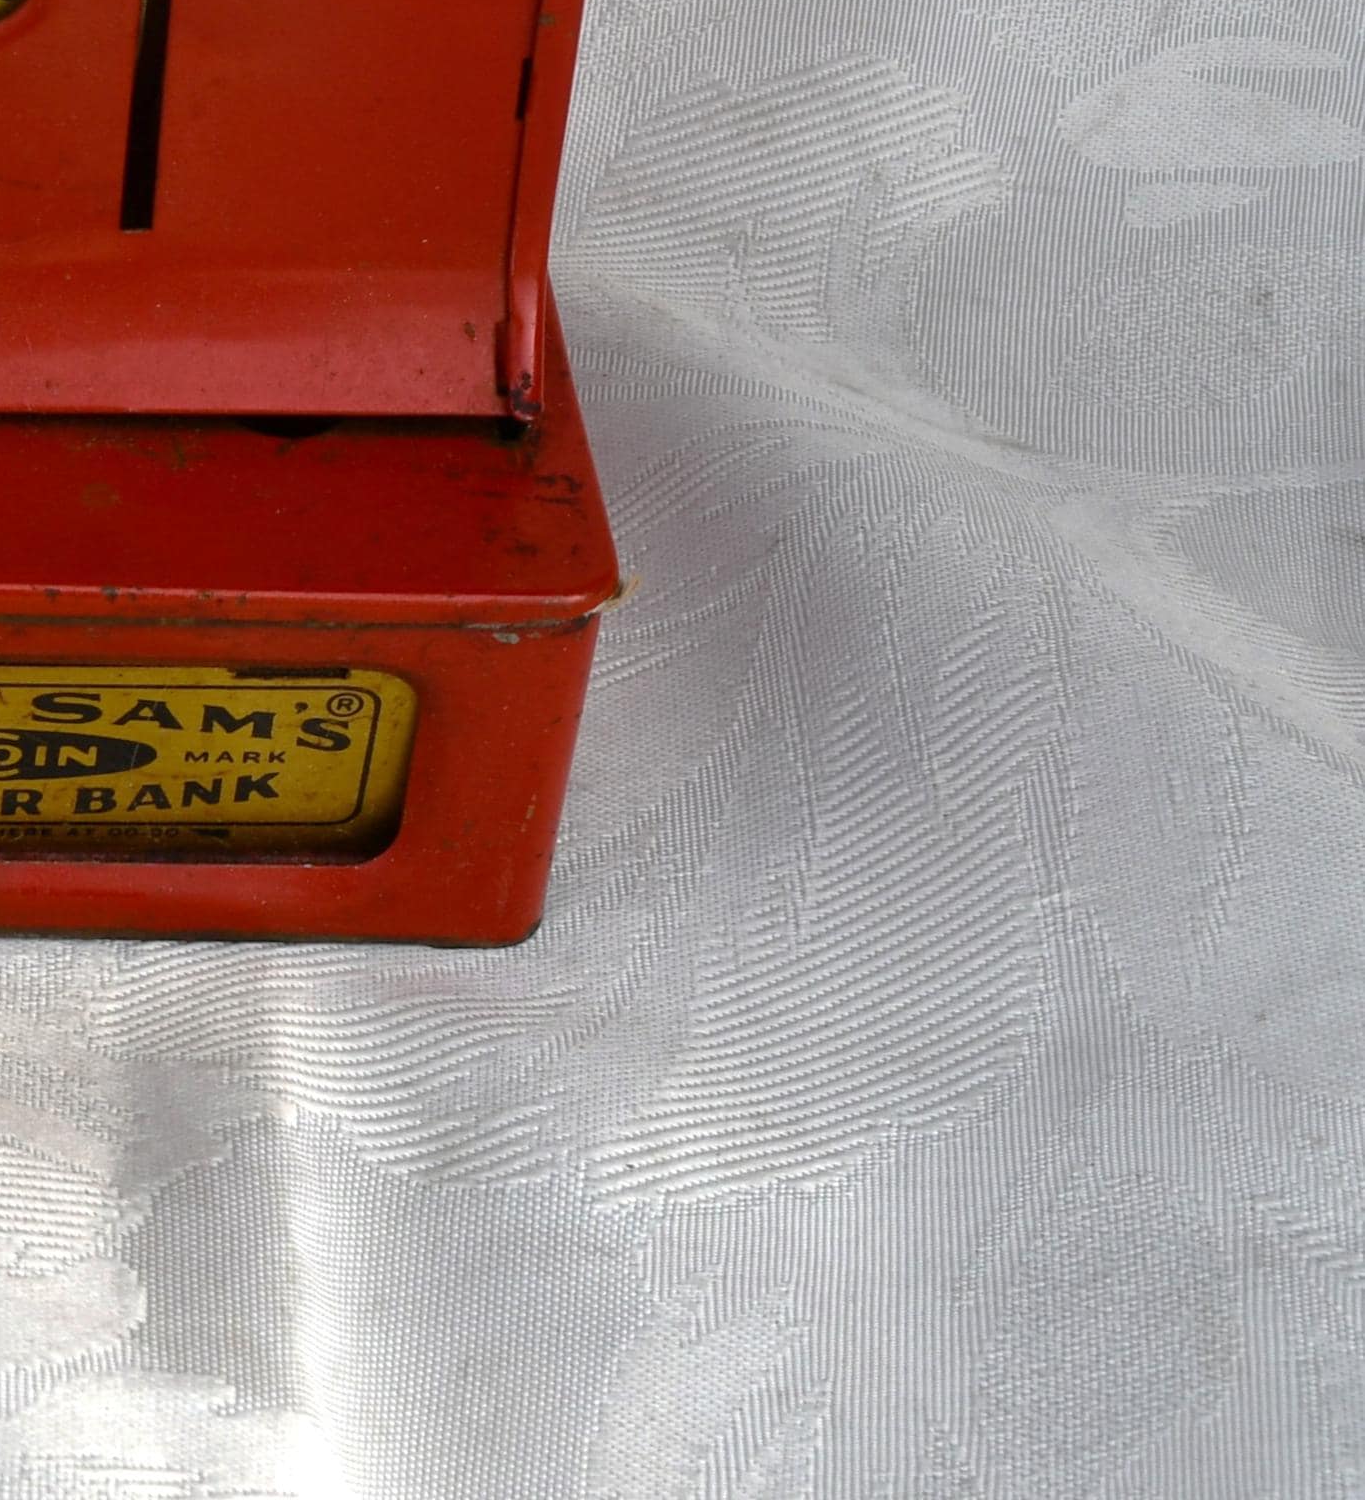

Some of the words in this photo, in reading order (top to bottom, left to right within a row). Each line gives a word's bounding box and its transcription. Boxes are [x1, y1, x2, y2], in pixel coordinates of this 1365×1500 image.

[30, 691, 353, 752] SAM'S
[184, 750, 286, 764] MARK
[72, 771, 280, 816] BANK
